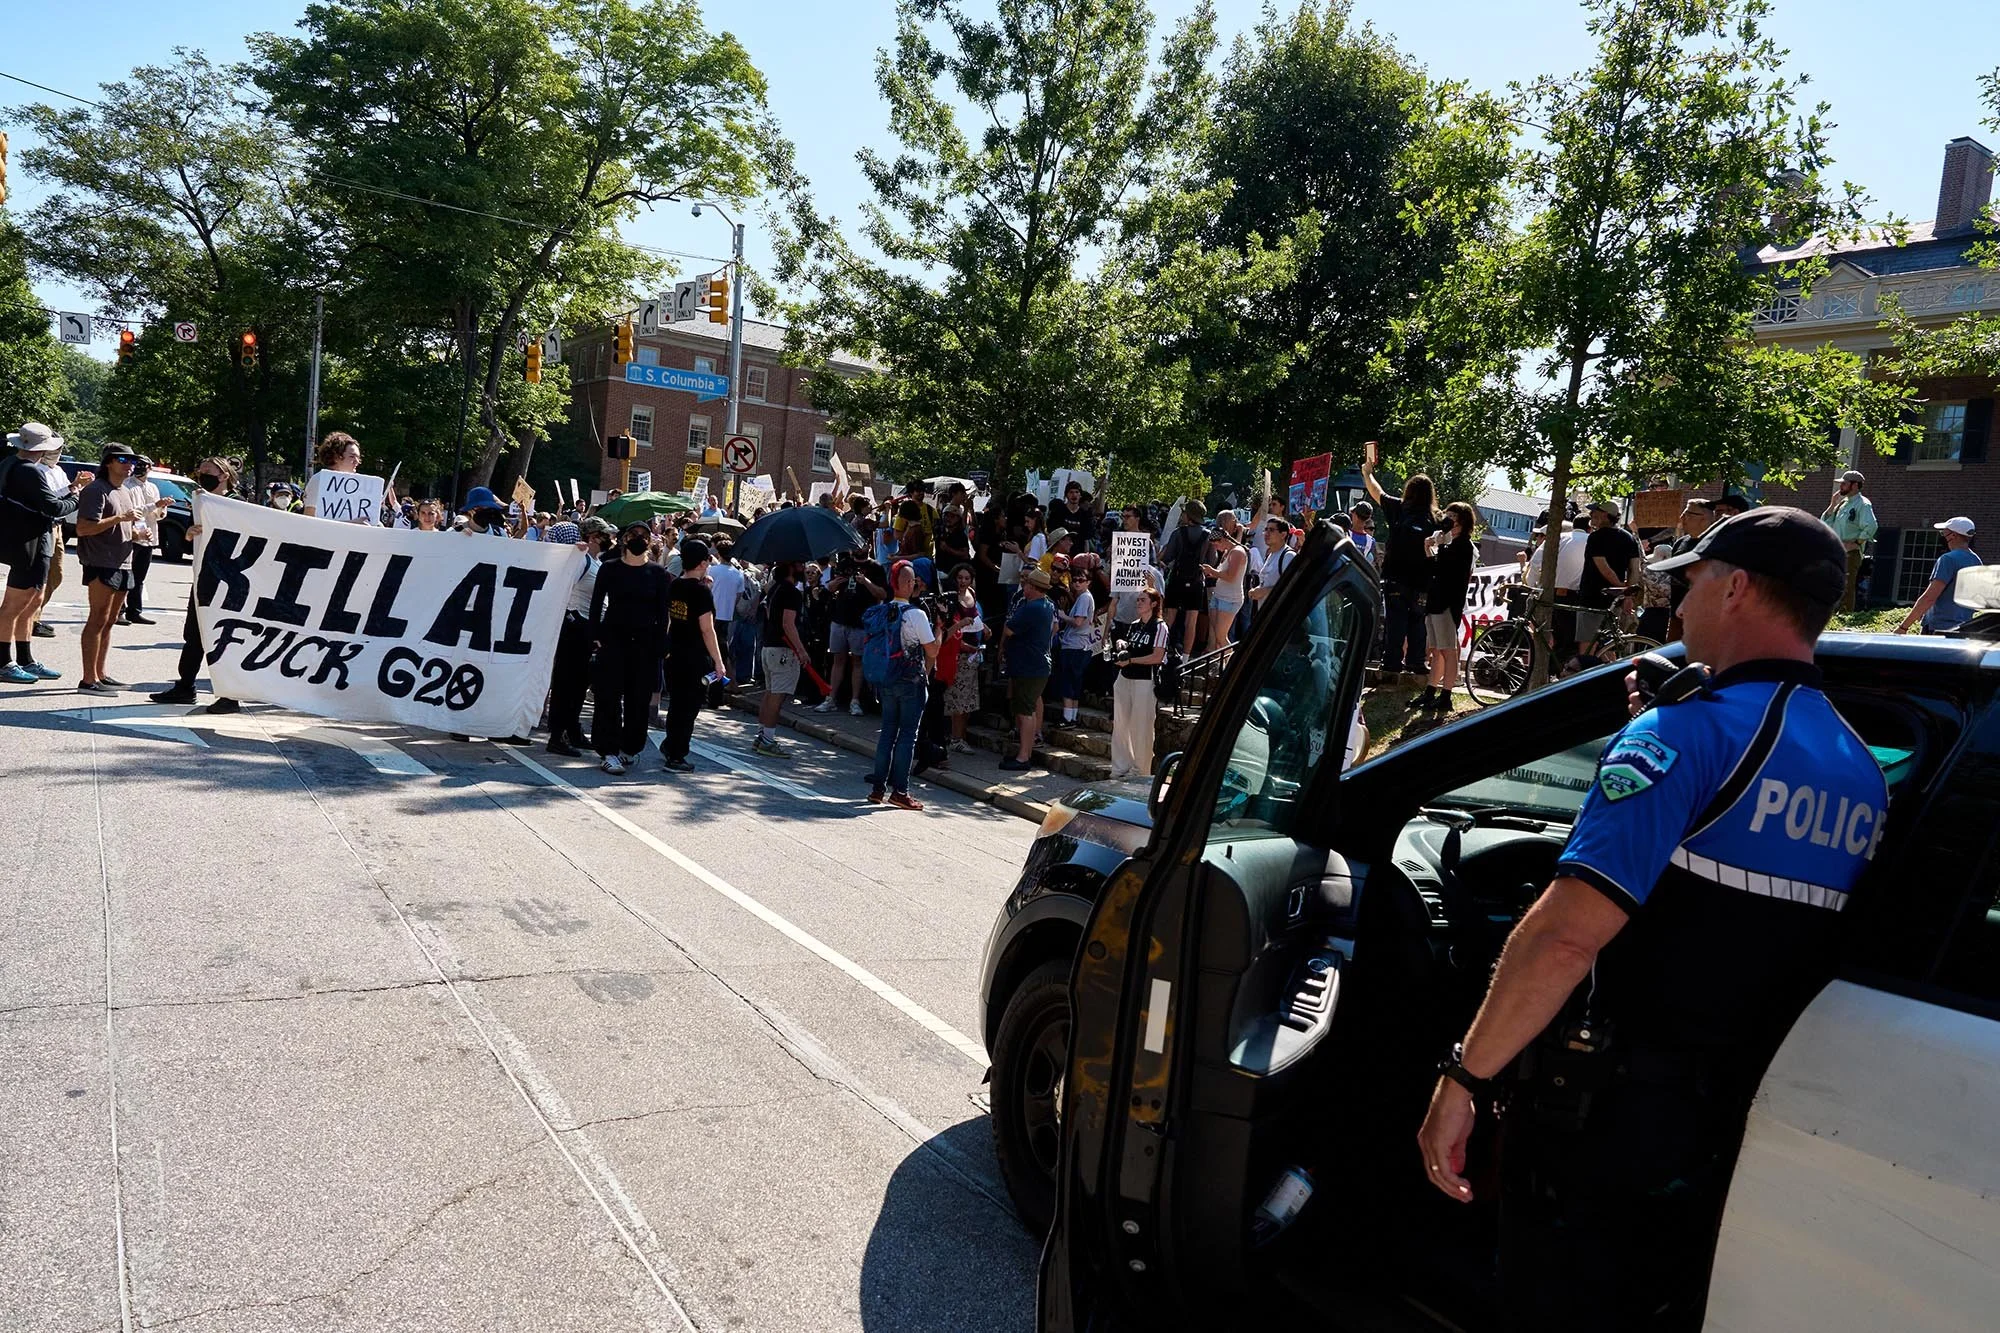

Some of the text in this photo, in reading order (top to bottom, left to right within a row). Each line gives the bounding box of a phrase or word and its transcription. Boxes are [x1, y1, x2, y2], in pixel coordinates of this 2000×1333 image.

[677, 310, 692, 318] ONLY
[641, 326, 656, 335] ONLY
[65, 333, 86, 341] ONLY
[646, 369, 726, 390] S. Columbia St
[326, 476, 360, 494] NO
[322, 497, 371, 521] WAR
[1117, 537, 1147, 547] INVEST
[1117, 548, 1147, 557] IN JOBS
[1116, 569, 1146, 578] ALTMAN'S
[198, 528, 413, 638] KILL
[1115, 579, 1146, 587] PROFITS
[423, 562, 549, 654] AI
[206, 618, 365, 691] FUCK
[1609, 774, 1632, 786] POLICE
